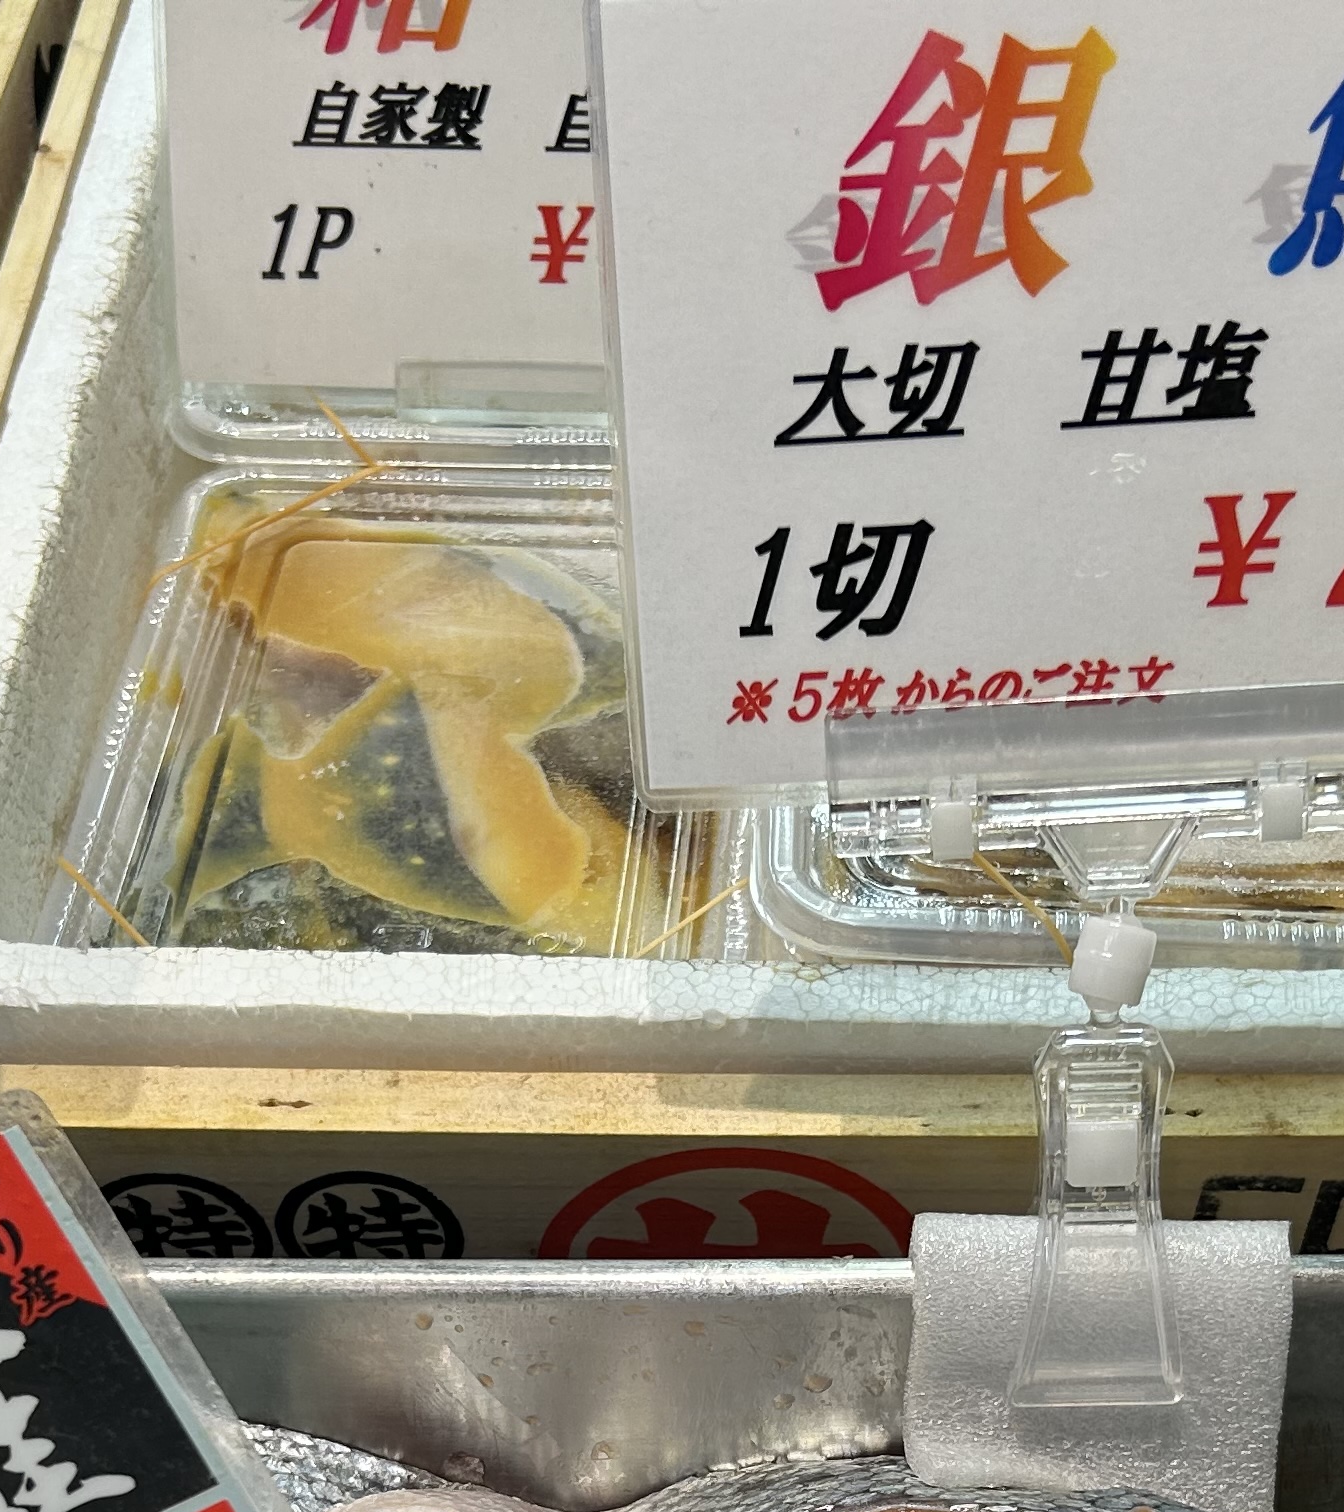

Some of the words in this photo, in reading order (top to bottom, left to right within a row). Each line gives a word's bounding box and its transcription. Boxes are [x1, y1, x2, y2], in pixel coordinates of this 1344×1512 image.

[296, 80, 492, 148] 自家製
[814, 27, 1117, 313] 銀
[261, 203, 355, 280] 1P
[774, 340, 980, 445] 大切
[1061, 320, 1269, 430] 甘塩
[739, 518, 936, 641] 1切
